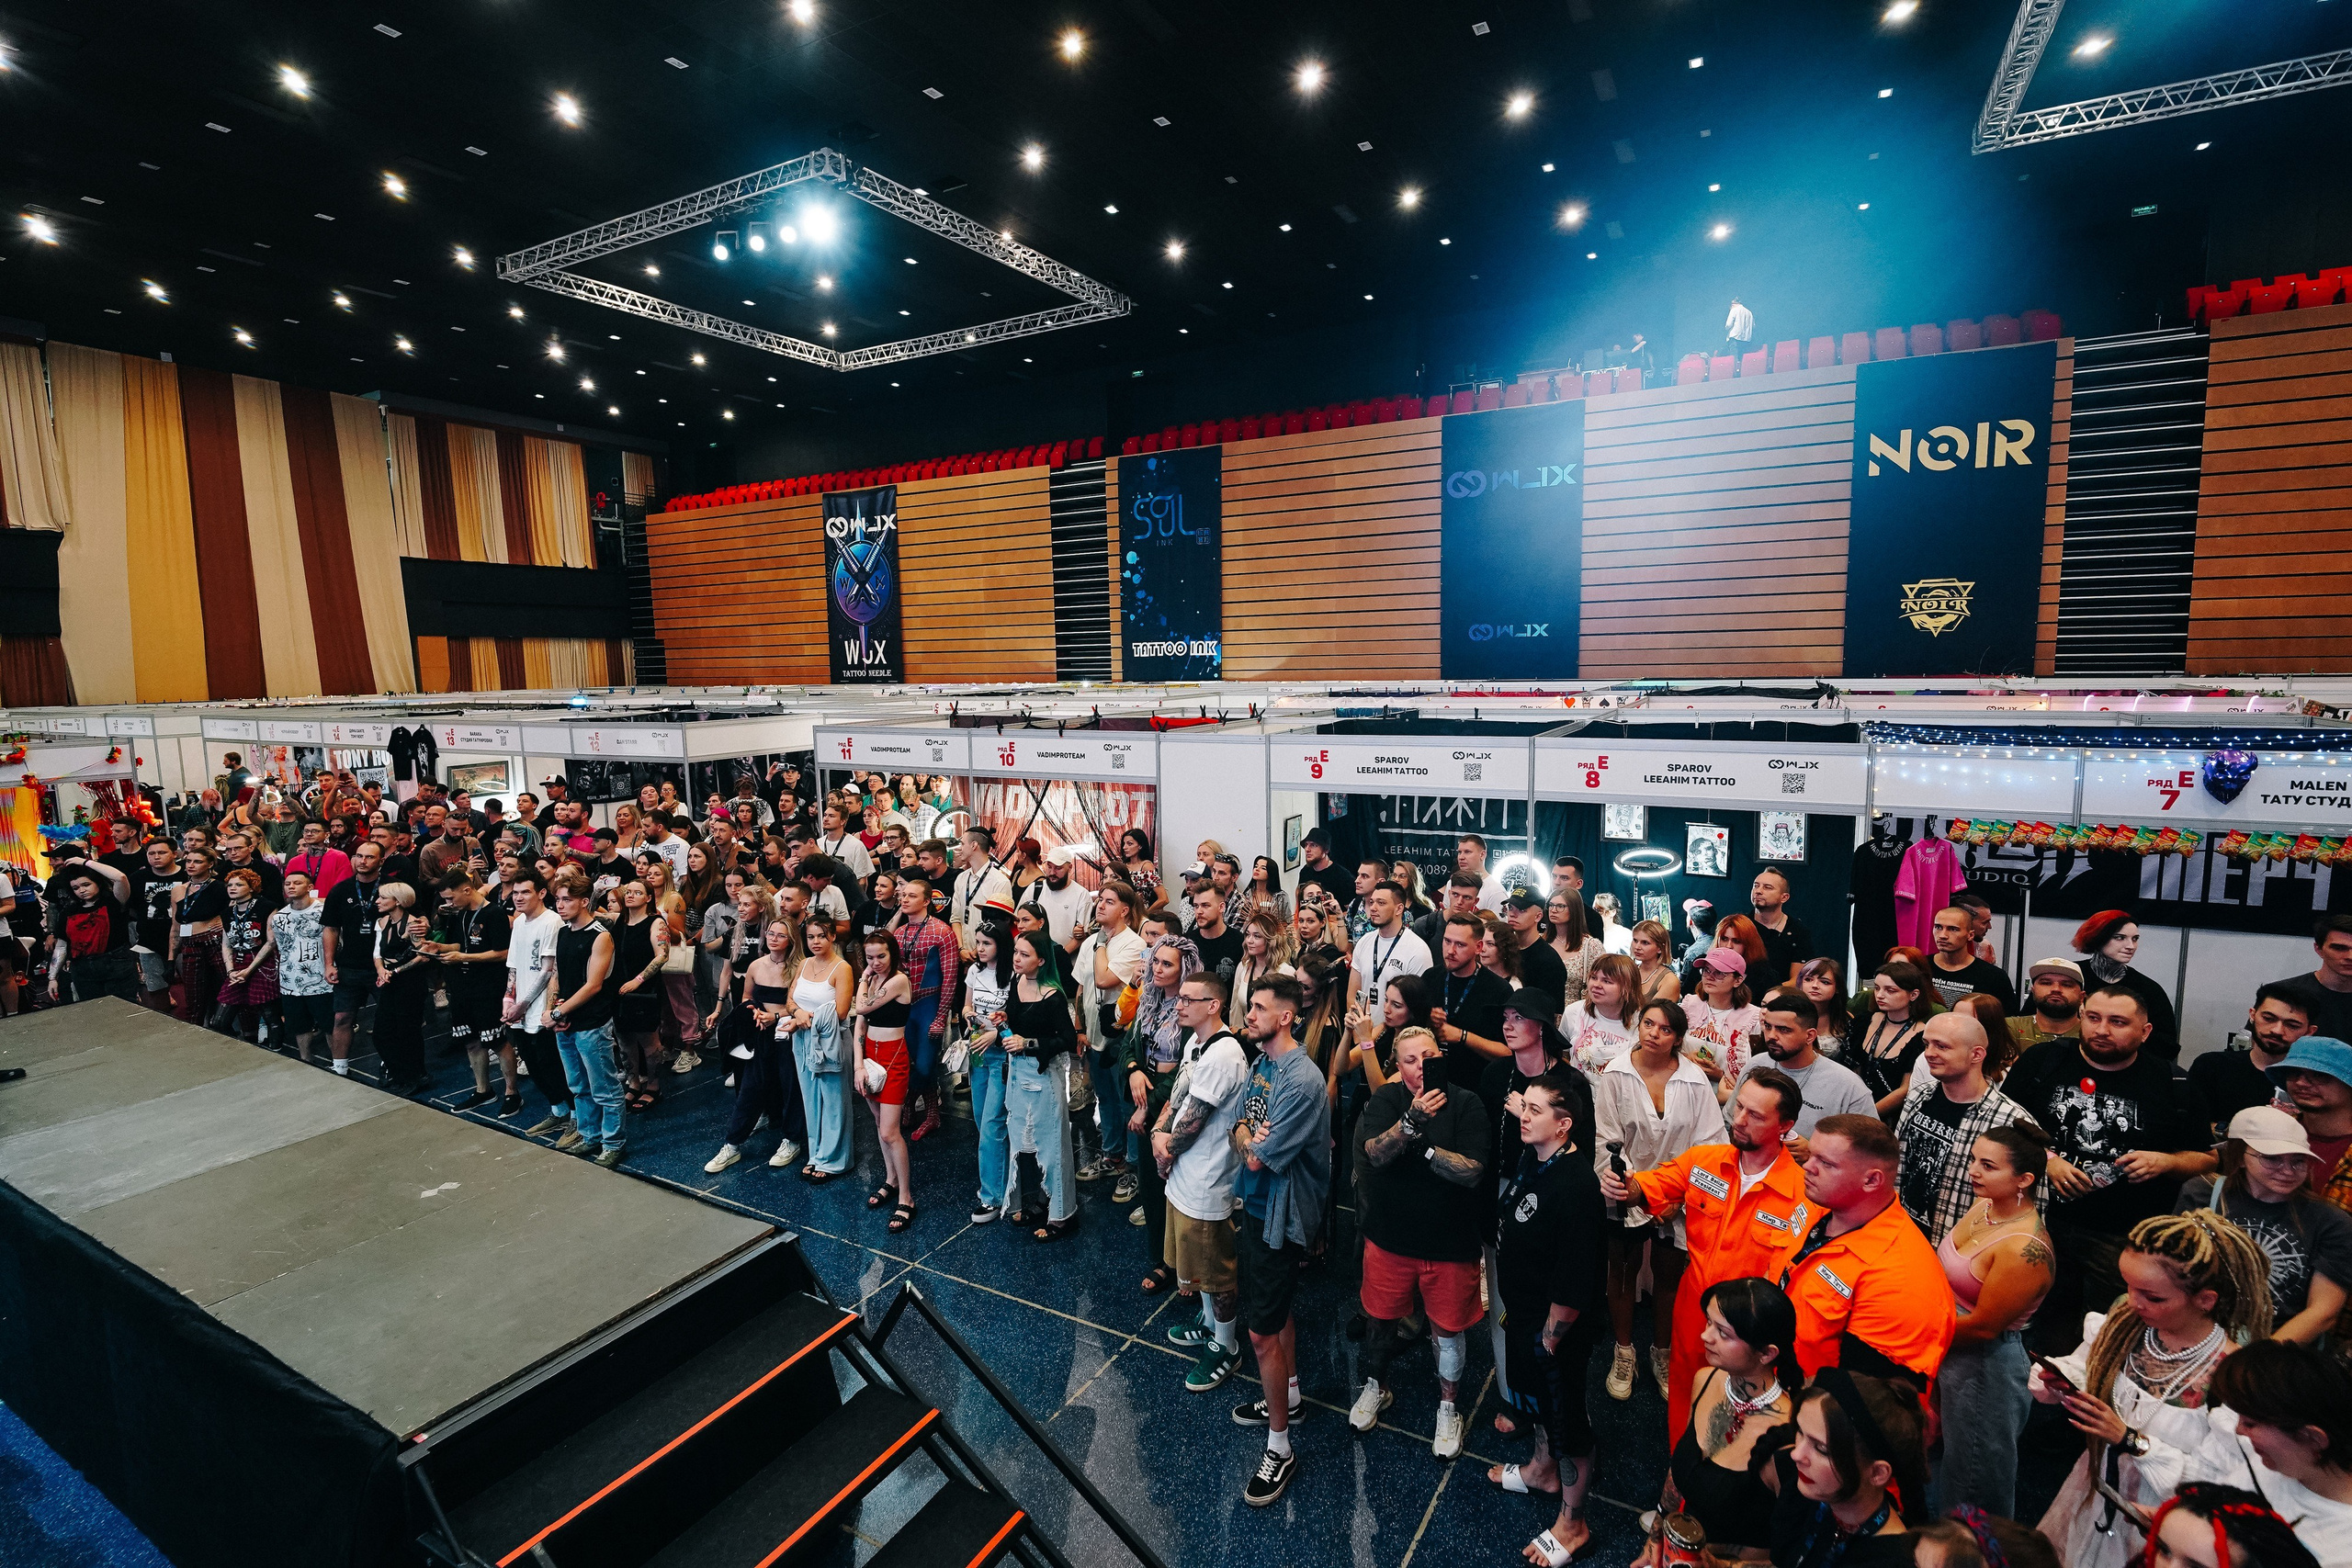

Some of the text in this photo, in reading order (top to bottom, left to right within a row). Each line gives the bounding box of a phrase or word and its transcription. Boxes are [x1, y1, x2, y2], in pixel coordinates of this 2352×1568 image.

[1868, 419, 2035, 477] NOIR
[1900, 599, 1971, 615] NOIR
[1132, 640, 1218, 657] TATTOO INK
[868, 669, 892, 677] NEEDLE
[334, 733, 340, 741] 14
[447, 736, 455, 746] 13
[590, 740, 600, 751] 12
[333, 749, 368, 770] TONY
[841, 748, 852, 761] 11
[999, 753, 1015, 767] 10
[1036, 751, 1086, 760] VADIMPROTEAM
[1374, 756, 1410, 764] SPAROV
[1310, 763, 1323, 779] 9
[1356, 766, 1429, 775] LEEAHIM TATTOO
[1577, 762, 1595, 771] РЯД
[1667, 763, 1713, 773] SPAROV
[1585, 771, 1600, 788] 8
[1644, 774, 1736, 786] LEEAHIM TATTOO
[2147, 779, 2174, 789] РЯД
[2290, 780, 2347, 792] MALEN
[2159, 789, 2181, 811] 7
[2260, 794, 2351, 808] ТАТУ СТУД
[1384, 845, 1432, 856] LEEAHIM
[1388, 958, 1404, 971] PUMA
[1947, 980, 1974, 990] ПОЗНАНИИ
[1697, 1169, 1709, 1180] Lord
[1694, 1179, 1721, 1196] President
[1761, 1213, 1776, 1224] Мир
